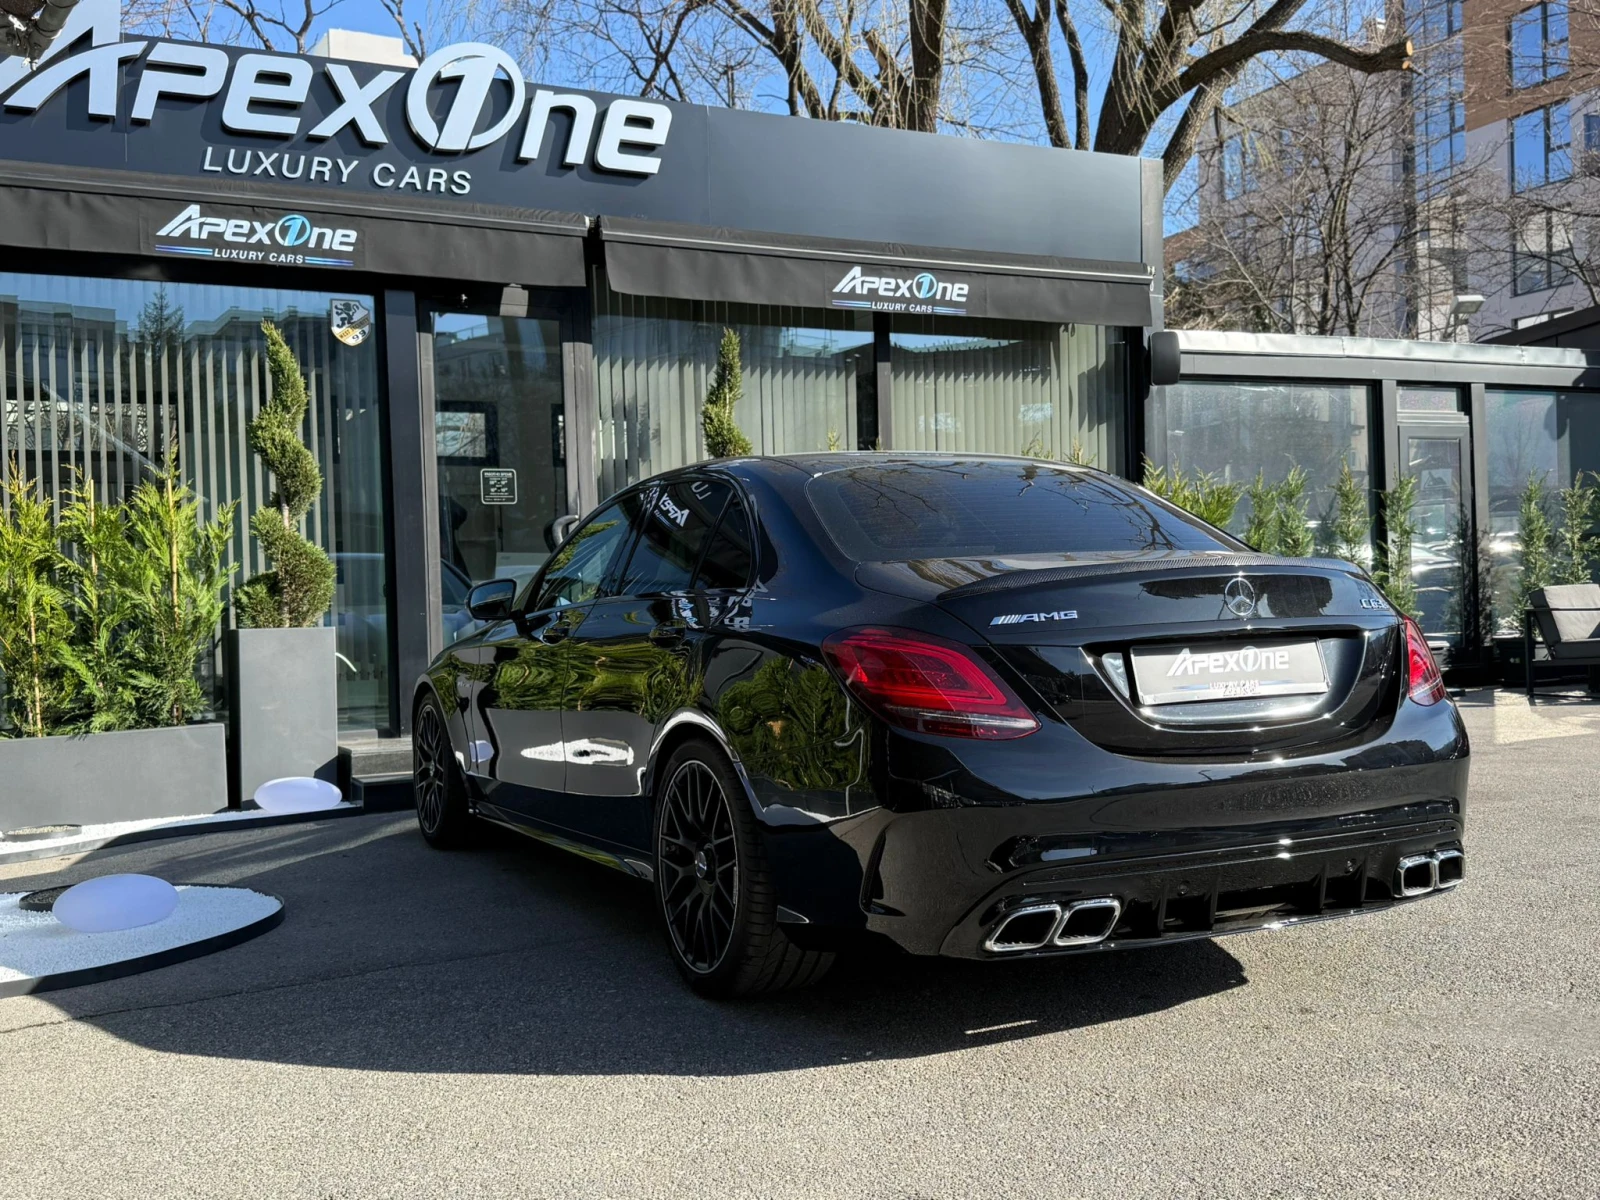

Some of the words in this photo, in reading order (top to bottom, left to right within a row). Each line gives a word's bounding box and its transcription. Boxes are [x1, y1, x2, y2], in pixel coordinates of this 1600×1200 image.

[203, 146, 359, 183] LUXURY
[373, 162, 472, 195] CARS
[214, 248, 265, 261] LUXURY
[269, 252, 303, 264] CARS
[872, 301, 906, 311] LUXURY
[909, 304, 932, 313] CARS
[1018, 610, 1078, 623] AMG
